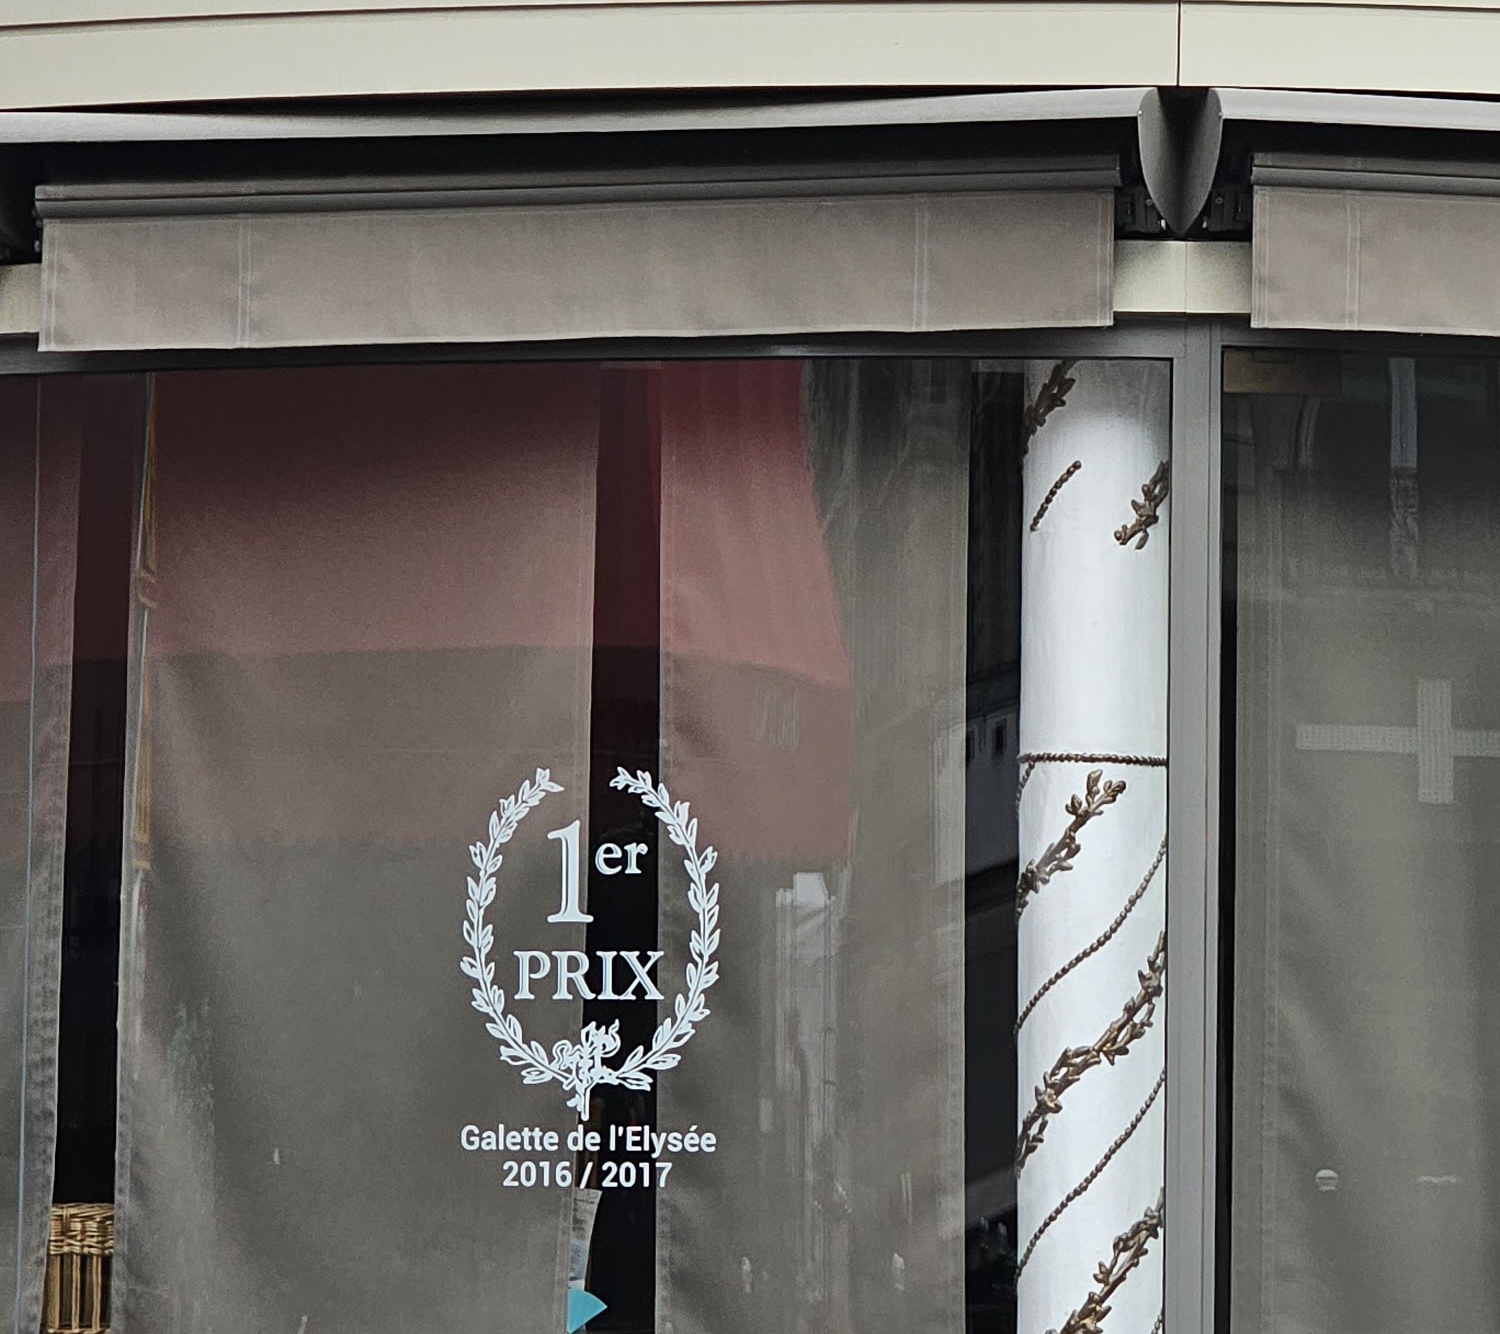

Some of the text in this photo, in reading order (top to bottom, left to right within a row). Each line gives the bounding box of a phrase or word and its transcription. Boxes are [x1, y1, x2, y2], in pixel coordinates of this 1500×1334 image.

[547, 820, 648, 923] 1er
[513, 950, 665, 1000] PRIX
[460, 1123, 717, 1159] Galette de l'Elysée
[502, 1162, 573, 1188] 2016
[601, 1162, 672, 1188] 2017
